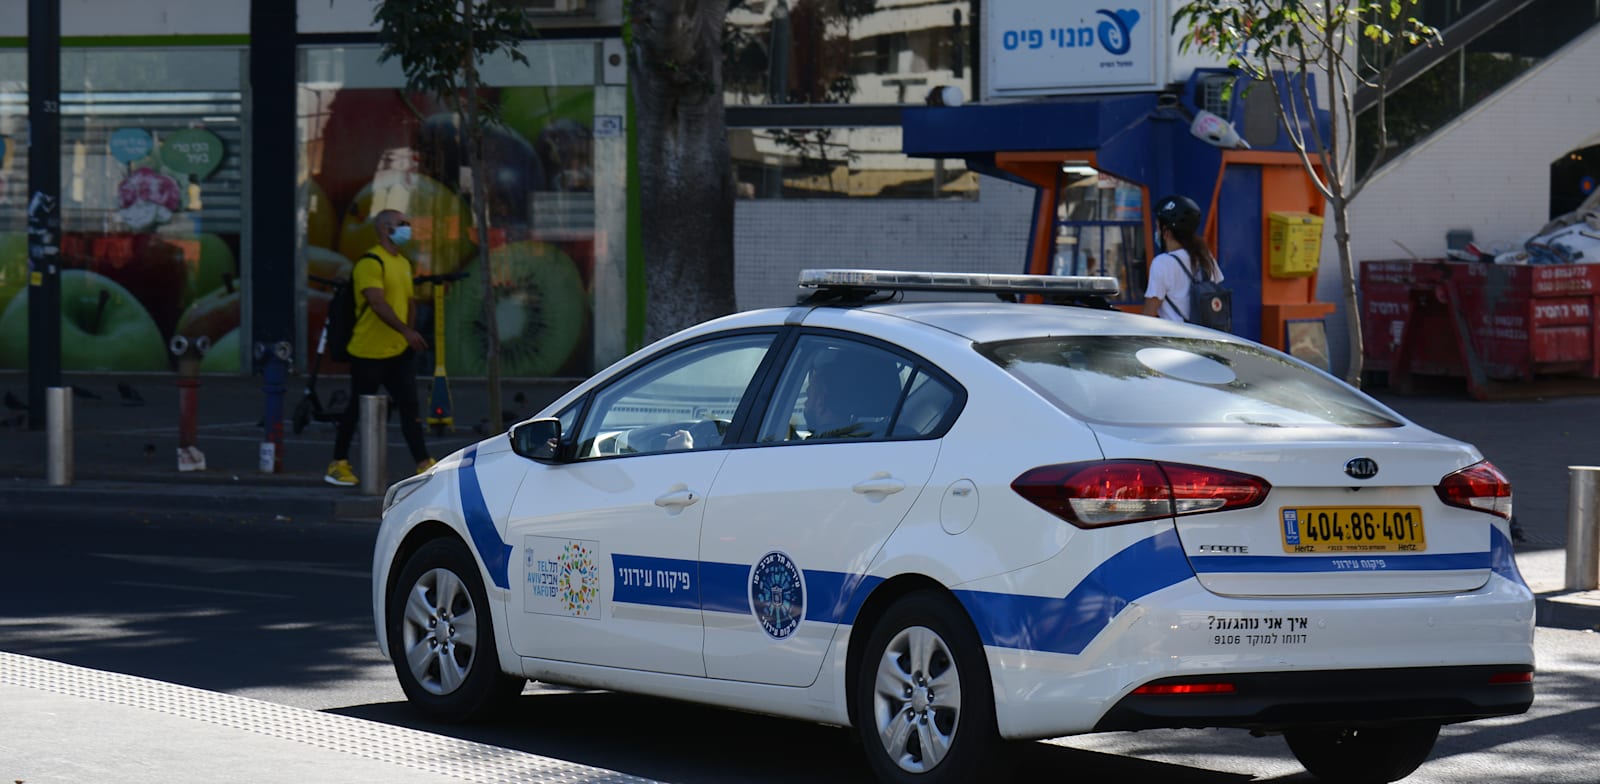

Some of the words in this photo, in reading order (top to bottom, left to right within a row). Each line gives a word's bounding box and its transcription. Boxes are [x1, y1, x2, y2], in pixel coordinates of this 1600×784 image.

[1003, 29, 1044, 50] פיס
[1050, 27, 1095, 47] מנוי
[1350, 461, 1376, 475] KIA
[1287, 519, 1297, 535] IL
[1199, 545, 1249, 554] FORTE
[1295, 544, 1315, 553] Hertz
[1398, 543, 1417, 552] Hertz
[537, 561, 549, 572] TEL
[548, 560, 558, 573] תל
[1332, 560, 1359, 569] עירוני
[1360, 559, 1386, 571] פיקוח
[527, 572, 541, 584] AVIV
[542, 573, 558, 585] אביב
[618, 567, 653, 587] עירוני
[656, 570, 691, 593] פיקוח
[533, 585, 549, 597] YAFO
[549, 586, 558, 597] יפו
[1263, 617, 1283, 629] אני
[1287, 617, 1308, 632] איך
[1214, 635, 1241, 645] 9106
[1245, 633, 1278, 647] למוקד
[1282, 634, 1307, 644] דווחו
